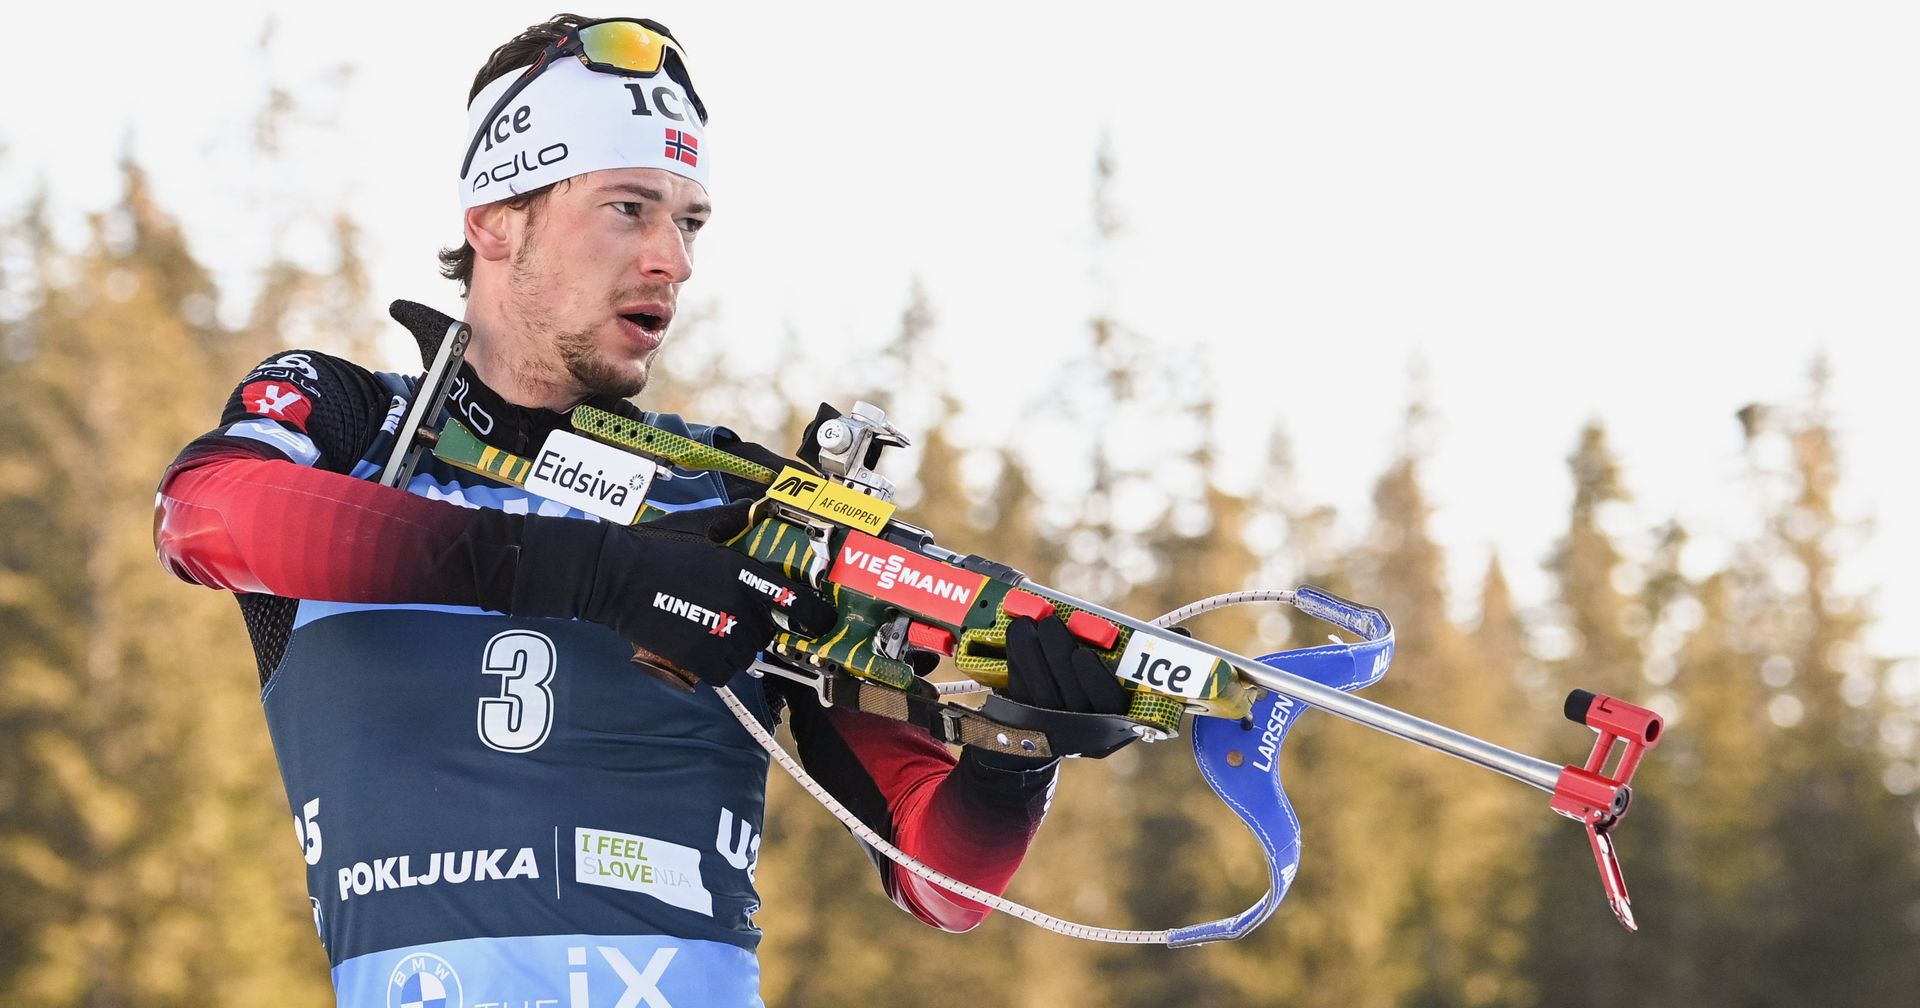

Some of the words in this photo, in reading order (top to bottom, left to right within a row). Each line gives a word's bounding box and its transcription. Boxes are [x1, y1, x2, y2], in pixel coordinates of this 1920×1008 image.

[533, 449, 628, 507] Eidsiva
[773, 477, 818, 497] AF
[819, 497, 834, 509] AF
[833, 501, 880, 527] GRUPPEN
[844, 546, 971, 605] VIESSMANN
[477, 629, 557, 753] 3
[1132, 651, 1191, 693] ice
[1253, 694, 1294, 772] LARSEN
[582, 834, 591, 852] I
[597, 836, 648, 861] FEEL
[338, 848, 539, 901] POKLJUKA
[393, 957, 450, 988] BMW
[567, 946, 680, 1008] iX
